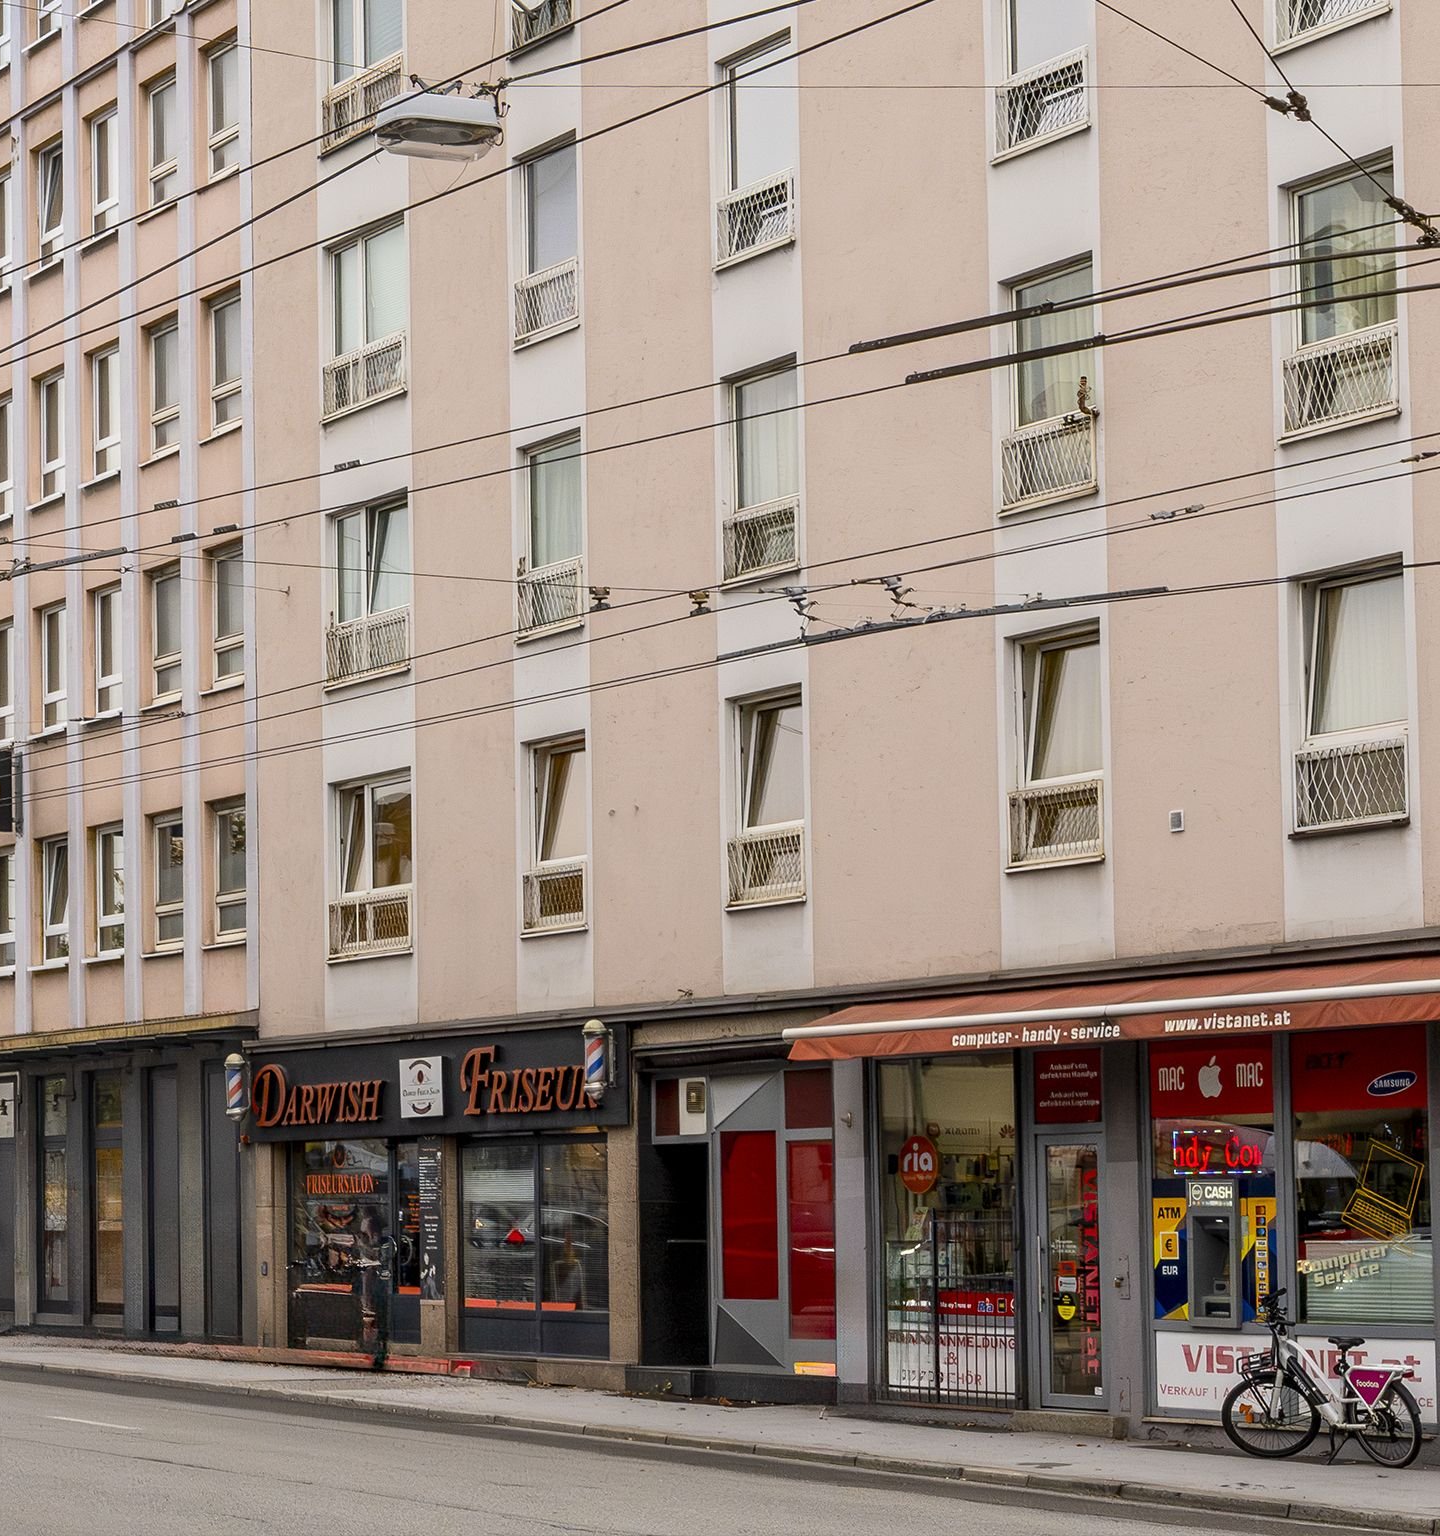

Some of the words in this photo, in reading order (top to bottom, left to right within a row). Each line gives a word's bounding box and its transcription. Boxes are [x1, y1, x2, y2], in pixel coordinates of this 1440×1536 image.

[1164, 1010, 1291, 1032] www.vistanet.at
[951, 1031, 1013, 1049] computer
[1022, 1025, 1061, 1045] handy
[1070, 1021, 1121, 1040] service
[1158, 1066, 1185, 1092] MAC
[1235, 1062, 1264, 1088] MAC
[1373, 1077, 1411, 1090] SAMSUNG
[903, 1142, 933, 1172] ria
[306, 1173, 375, 1195] FRISEURSALON
[1204, 1185, 1233, 1199] CASH
[1157, 1206, 1181, 1219] ATM
[1161, 1265, 1179, 1275] EUR
[1302, 1244, 1389, 1275] Computer
[1160, 1383, 1208, 1397] VERKAUF
[1355, 1379, 1380, 1389] foodora
